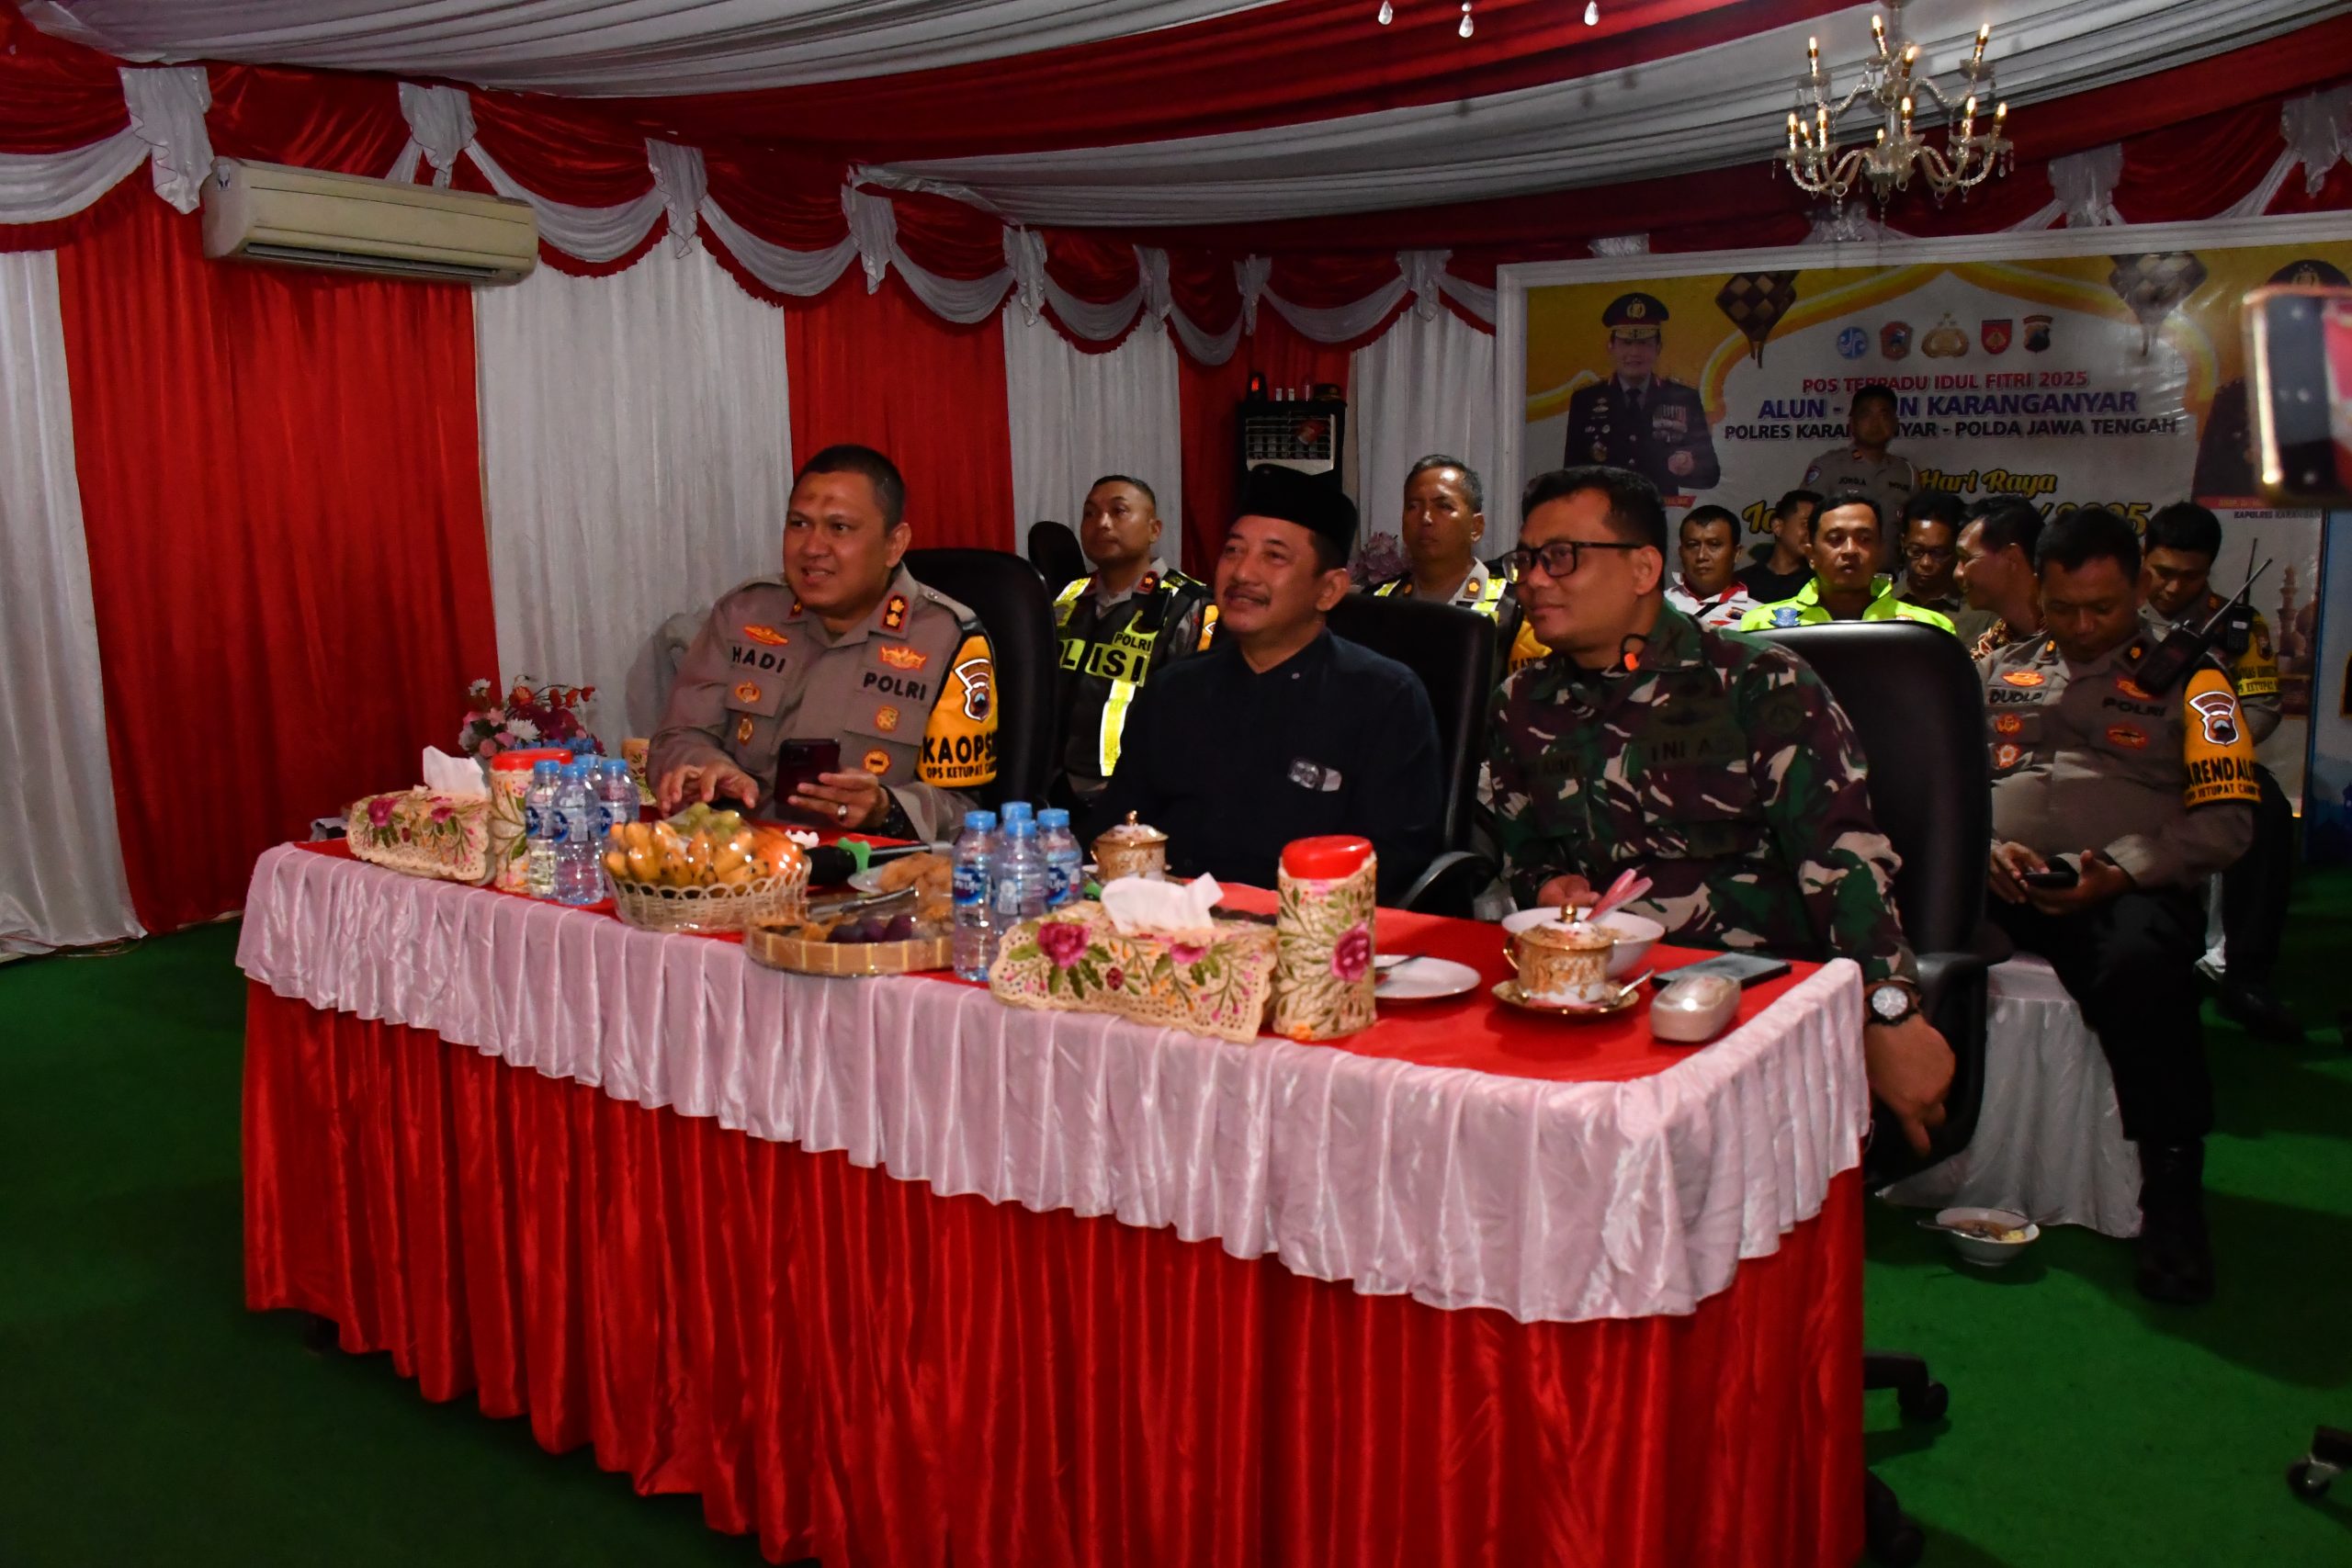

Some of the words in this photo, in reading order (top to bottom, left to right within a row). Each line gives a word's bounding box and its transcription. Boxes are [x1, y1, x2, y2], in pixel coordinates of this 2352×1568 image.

[1803, 378, 1838, 393] POS
[1934, 374, 1978, 390] IDUL
[1984, 372, 2032, 389] FITRI
[2039, 371, 2088, 387] 2025
[1758, 399, 1825, 420] ALUN
[1927, 391, 2137, 416] KARANGANYAR
[1724, 423, 1791, 440] POLRES
[1954, 421, 2021, 437] POLDA
[2027, 420, 2086, 436] JAWA
[2091, 418, 2177, 435] TENGAH
[1918, 468, 1978, 494] Hari
[1981, 468, 2058, 500] Raya
[1114, 633, 1152, 651] POLRI
[732, 647, 786, 673] HADI
[864, 672, 927, 701] POLRI
